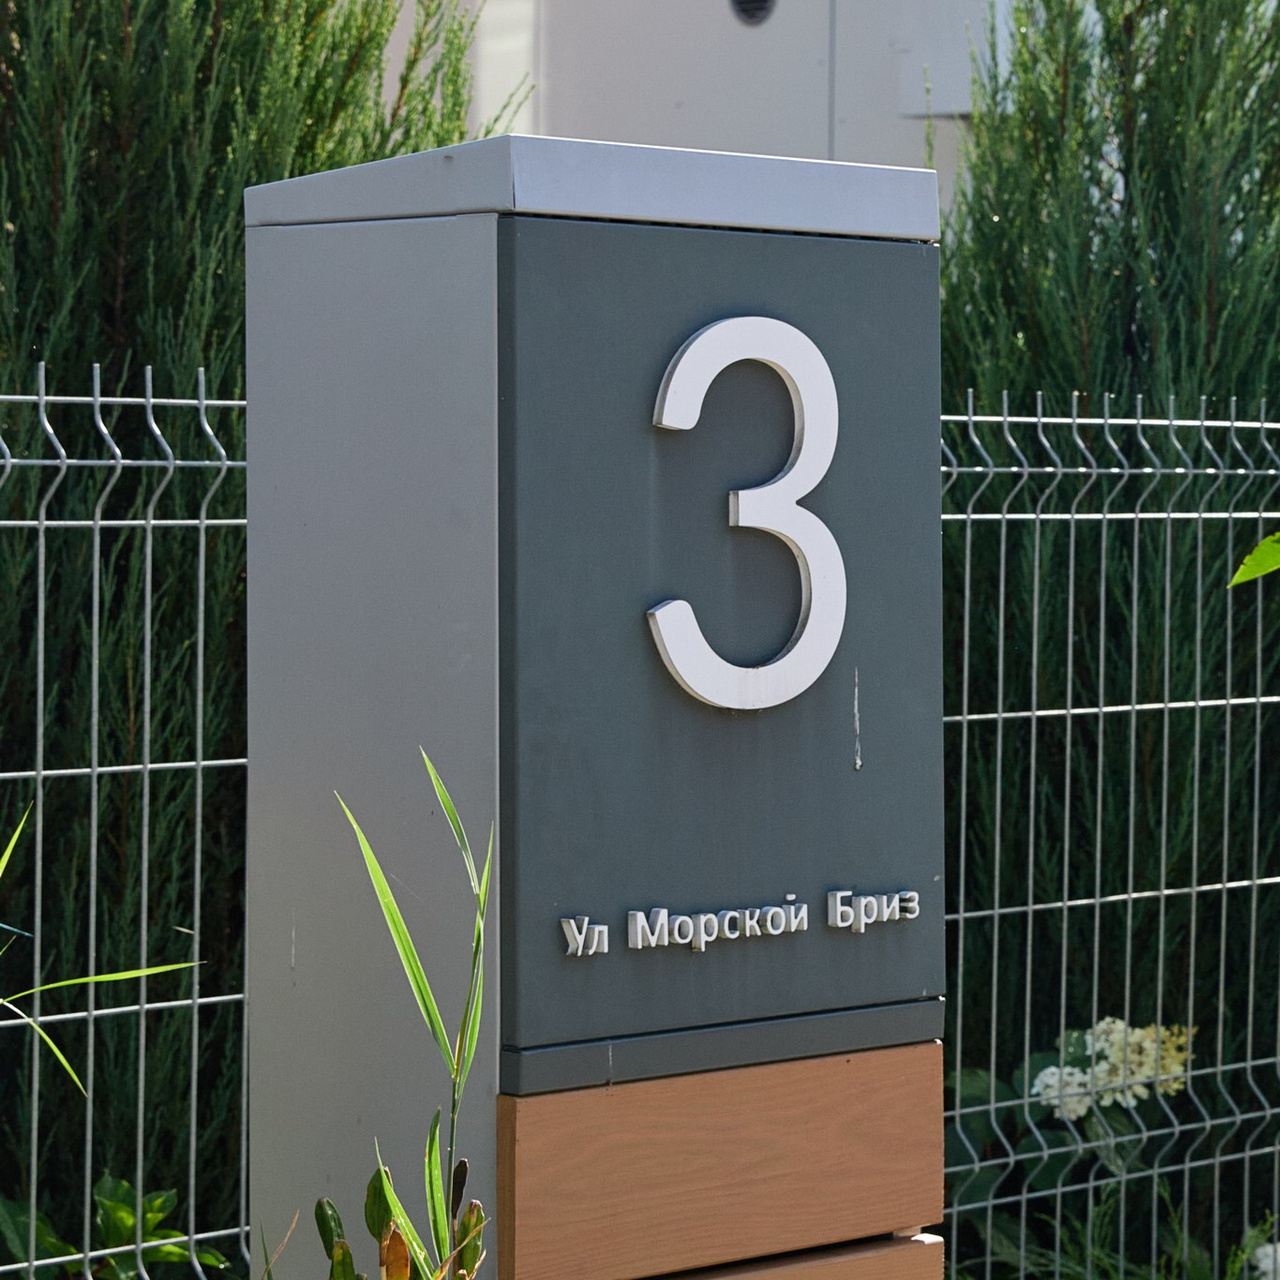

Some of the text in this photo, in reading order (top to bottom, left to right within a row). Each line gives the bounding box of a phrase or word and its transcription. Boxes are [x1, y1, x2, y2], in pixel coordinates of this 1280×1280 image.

[646, 315, 847, 710] 3
[562, 891, 920, 956] Ул Морской Бриз
